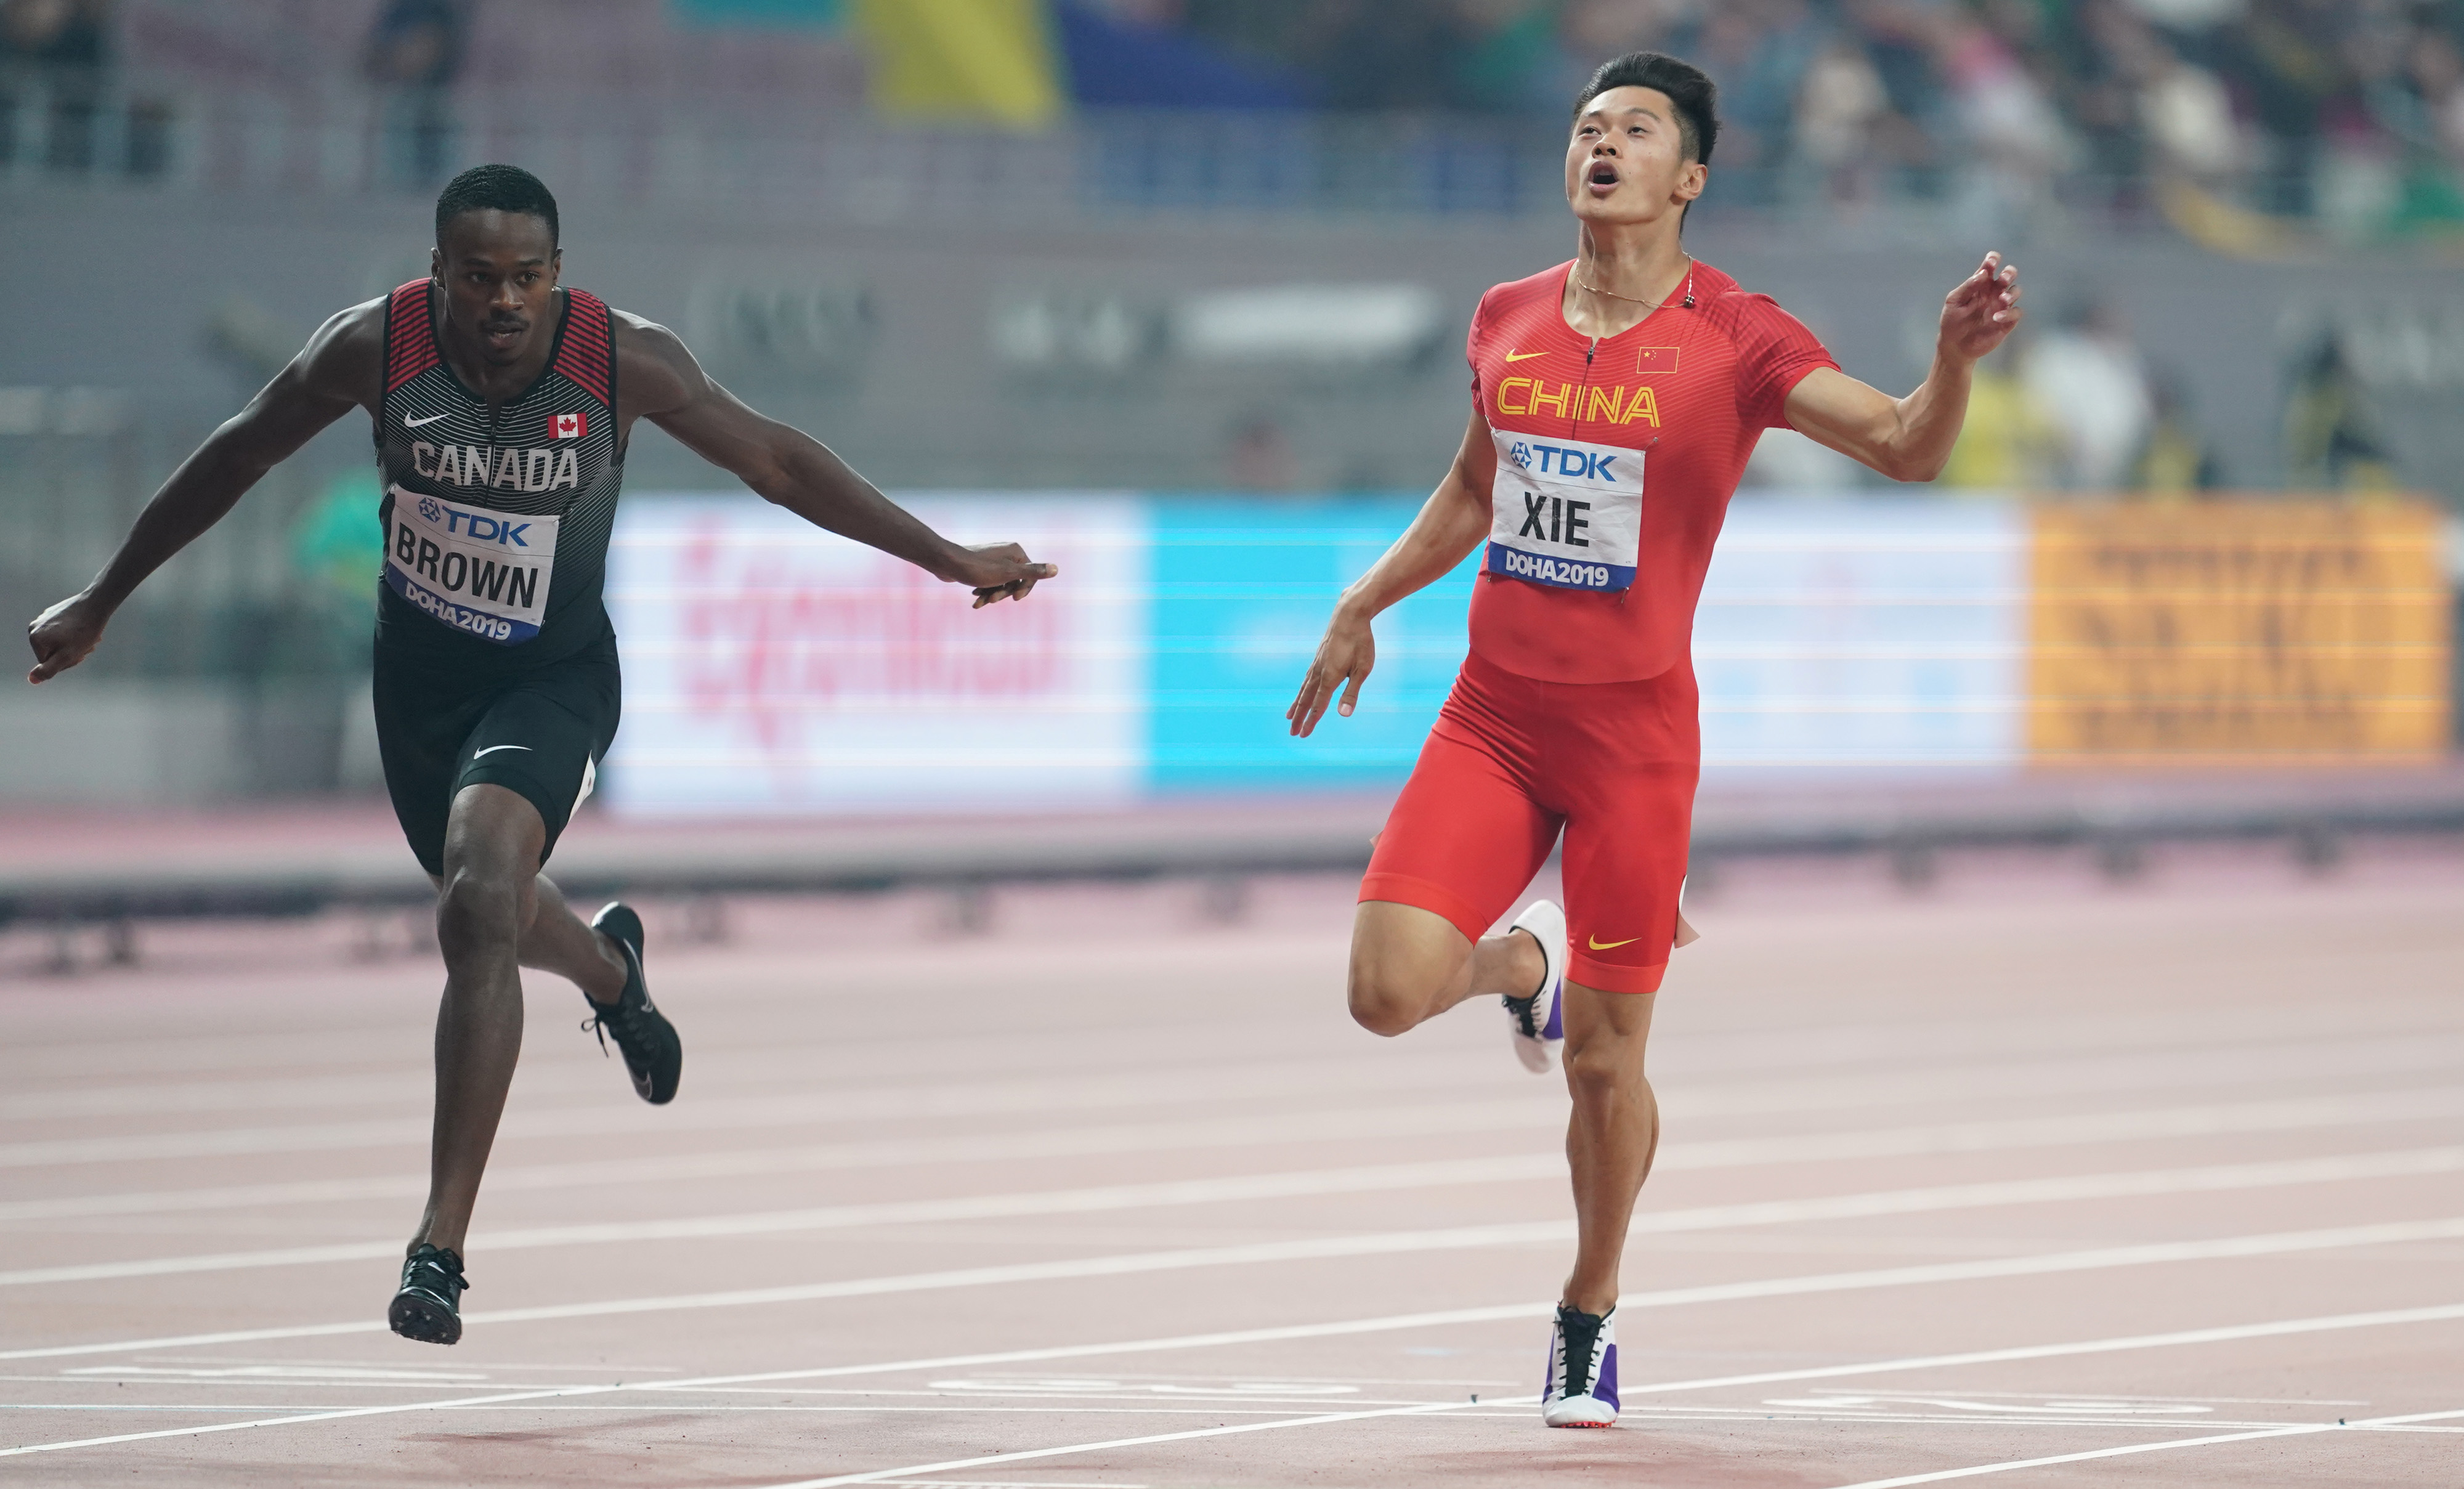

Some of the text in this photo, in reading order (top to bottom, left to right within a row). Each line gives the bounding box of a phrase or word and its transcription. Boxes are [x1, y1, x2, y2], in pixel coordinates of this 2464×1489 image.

[1497, 377, 1660, 428] CHINA
[413, 441, 578, 491] CANADA
[1533, 444, 1617, 482] TDK
[442, 505, 532, 547] TDK
[1518, 491, 1591, 547] XIE
[396, 522, 538, 609] BROWN
[1506, 550, 1609, 586] DOHA2019
[405, 580, 511, 640] DOHA2019
